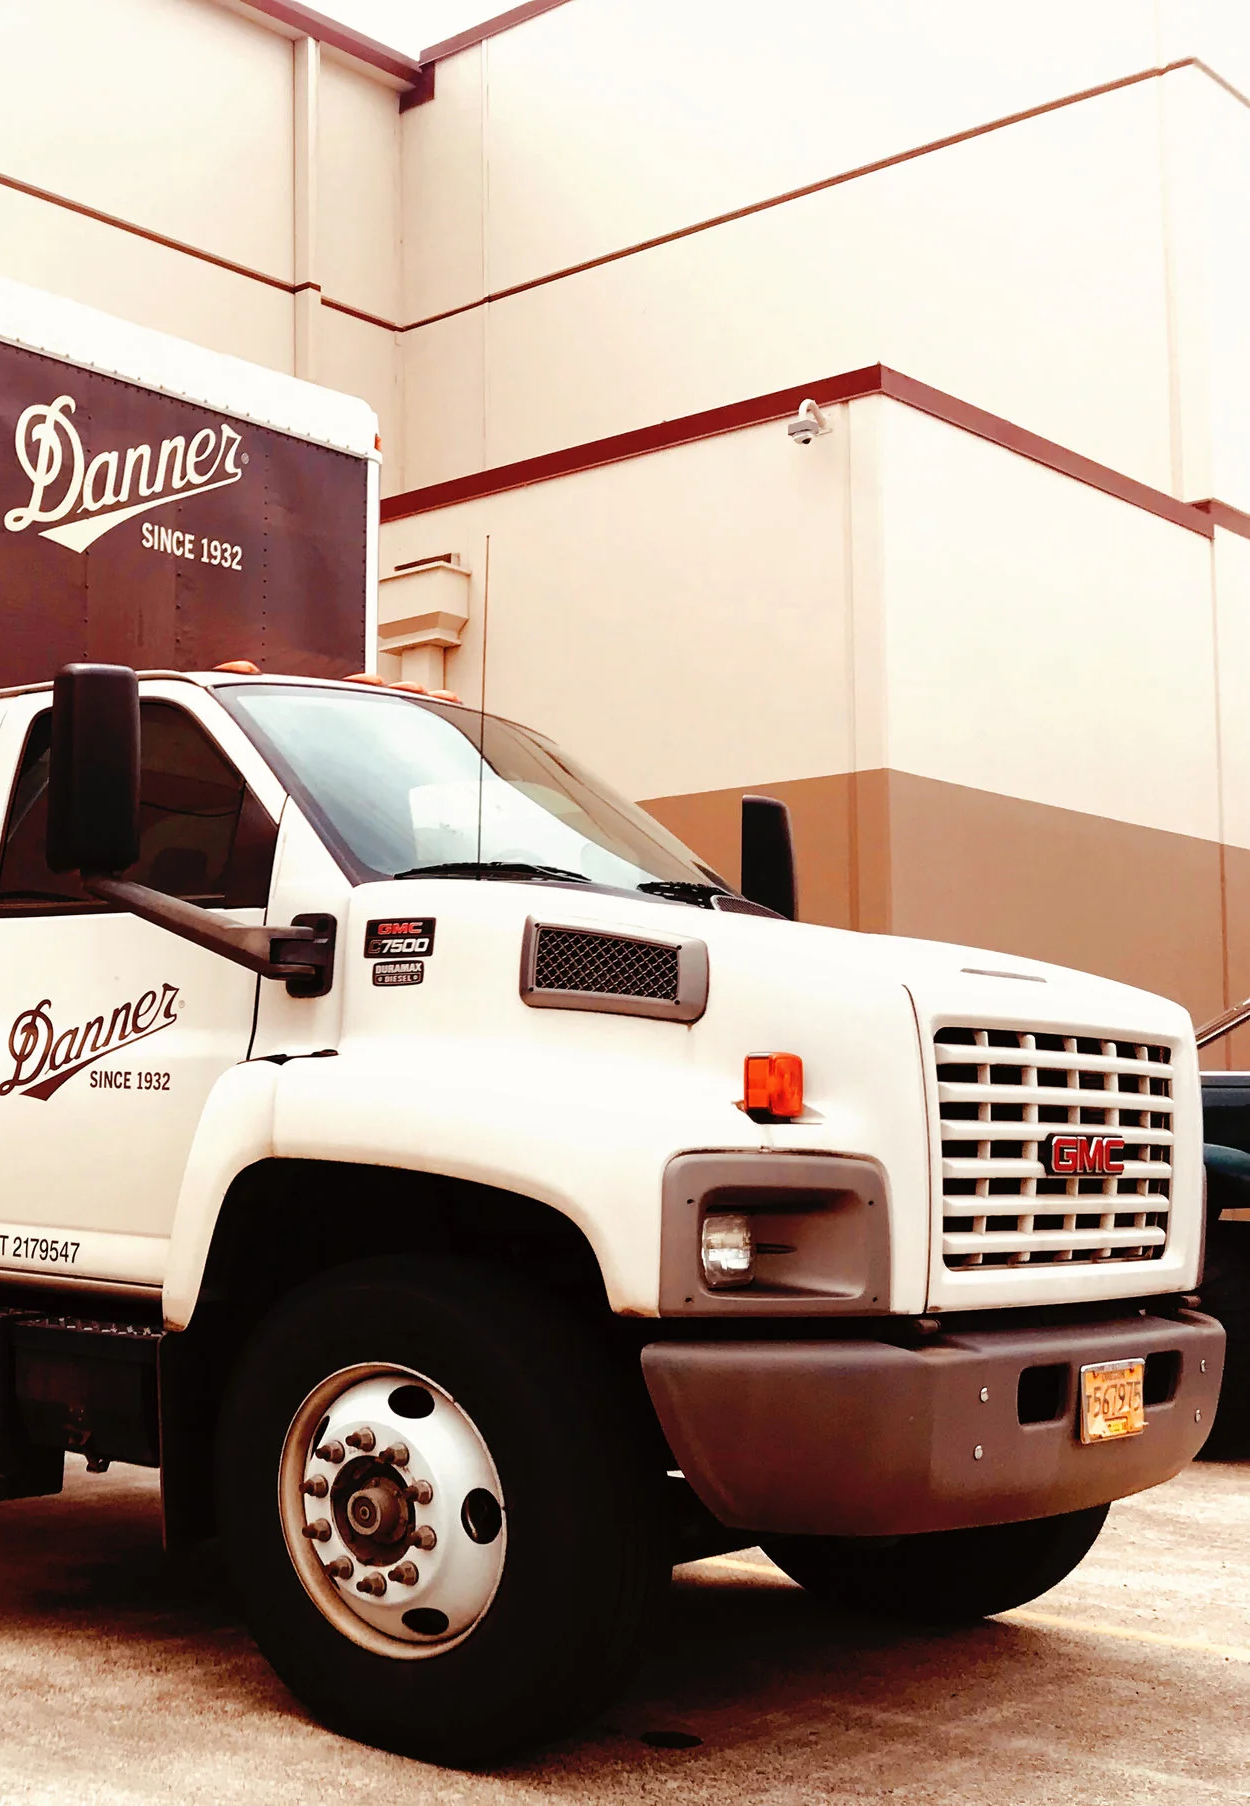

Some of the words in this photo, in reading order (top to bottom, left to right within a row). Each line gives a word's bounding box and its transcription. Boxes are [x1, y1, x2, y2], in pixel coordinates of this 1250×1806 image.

[4, 395, 243, 554] Danner
[141, 522, 195, 559] SINCE
[201, 538, 243, 571] 1932
[377, 922, 423, 935] GMC
[368, 938, 430, 954] C7500
[375, 963, 423, 974] DURAMAX
[384, 975, 412, 983] DIESEL
[89, 1070, 131, 1089] SINCE
[136, 1072, 171, 1091] 1932
[1052, 1136, 1125, 1173] GMC
[12, 1238, 80, 1264] 2179547
